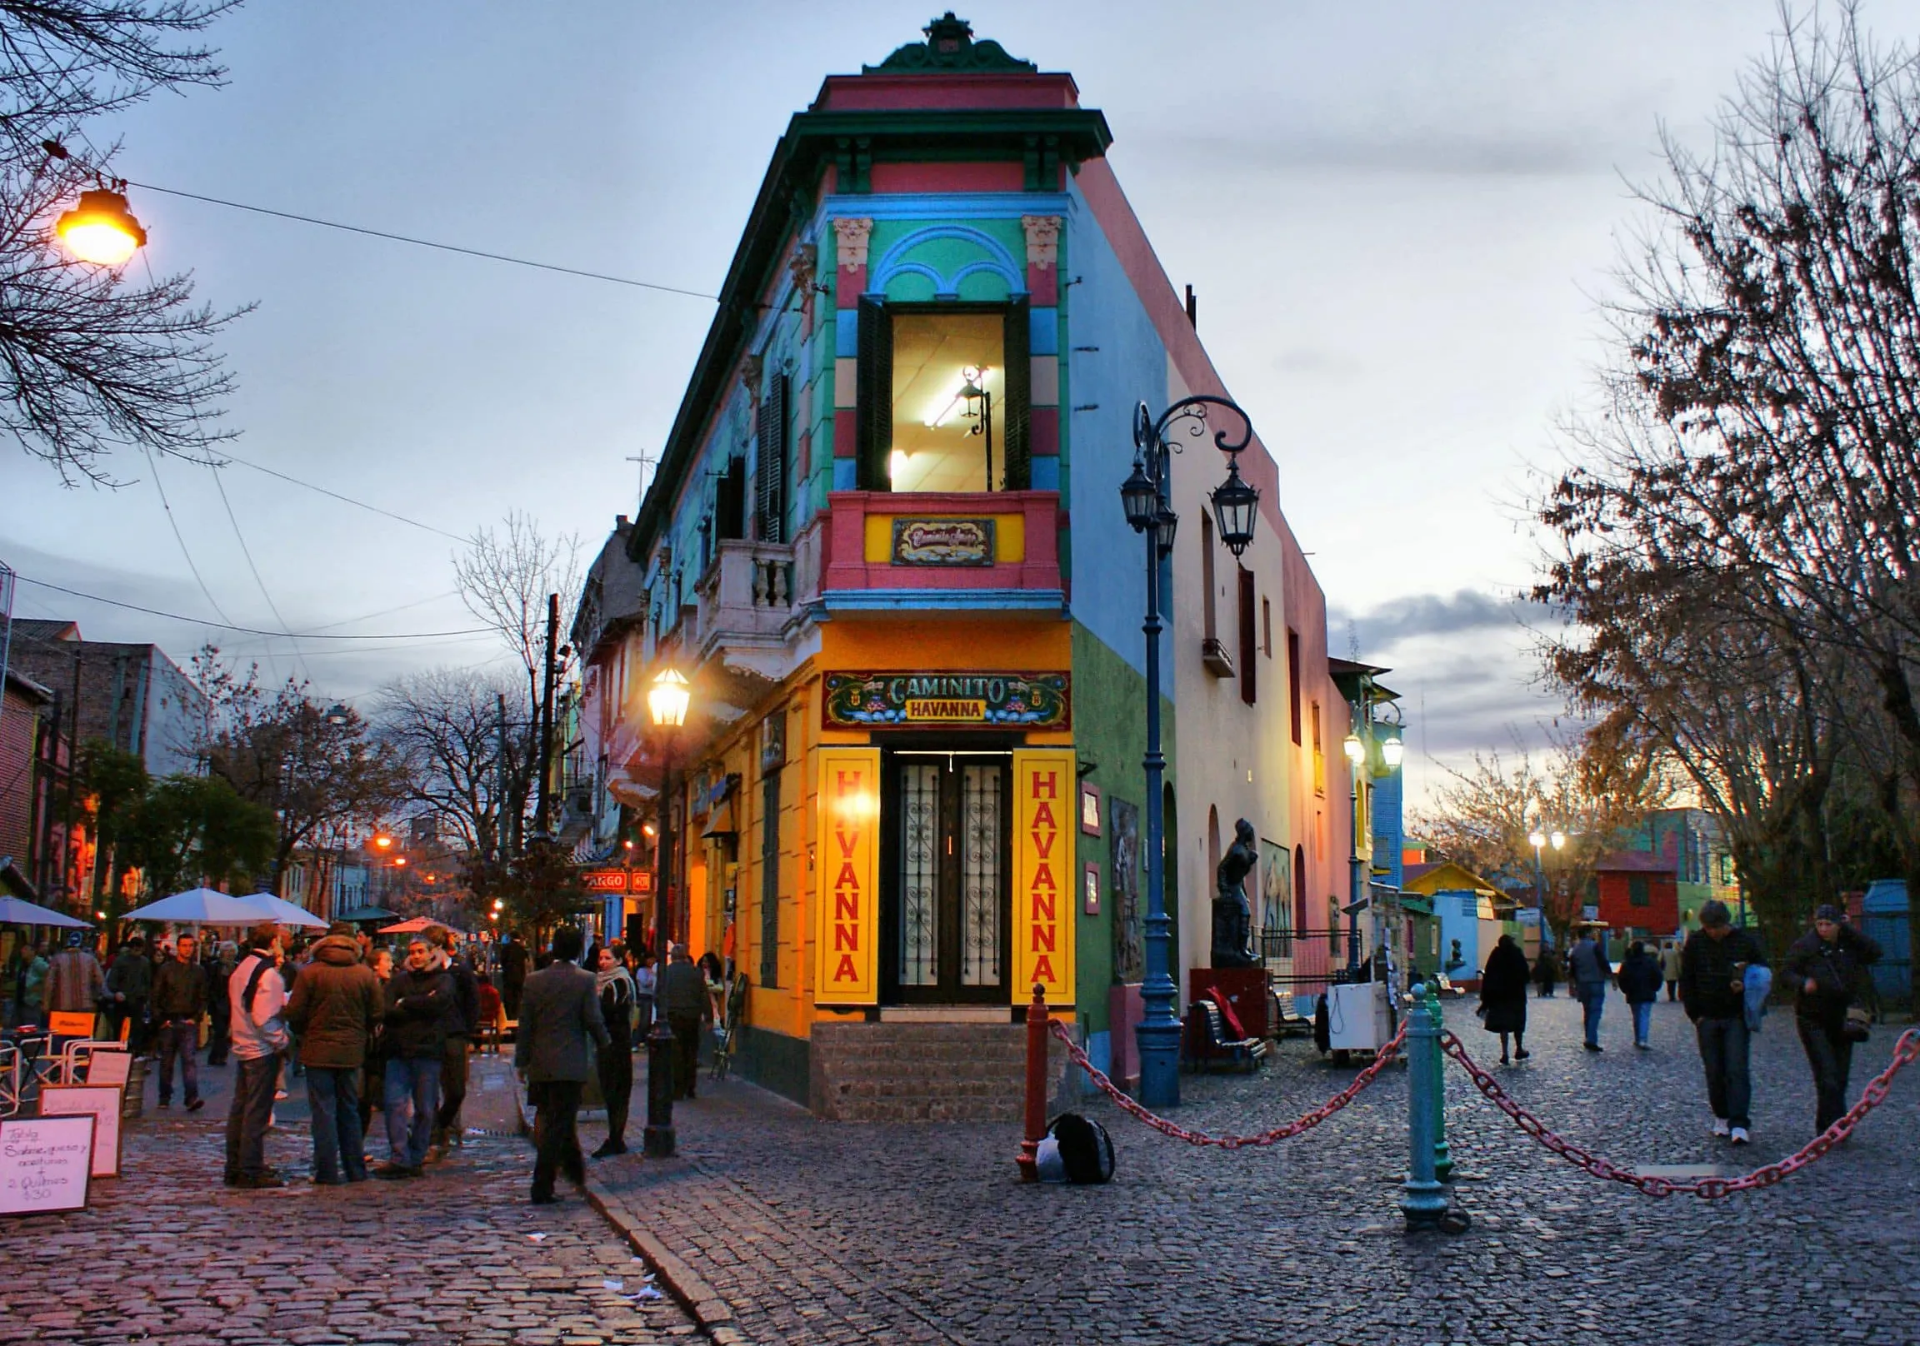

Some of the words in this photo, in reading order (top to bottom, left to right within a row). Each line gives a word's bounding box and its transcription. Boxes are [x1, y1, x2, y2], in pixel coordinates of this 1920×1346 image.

[891, 678, 1004, 703] CAMINITO
[910, 701, 980, 717] HAVANNA
[833, 770, 862, 982] HVANNA
[1031, 771, 1057, 983] HAVANNA
